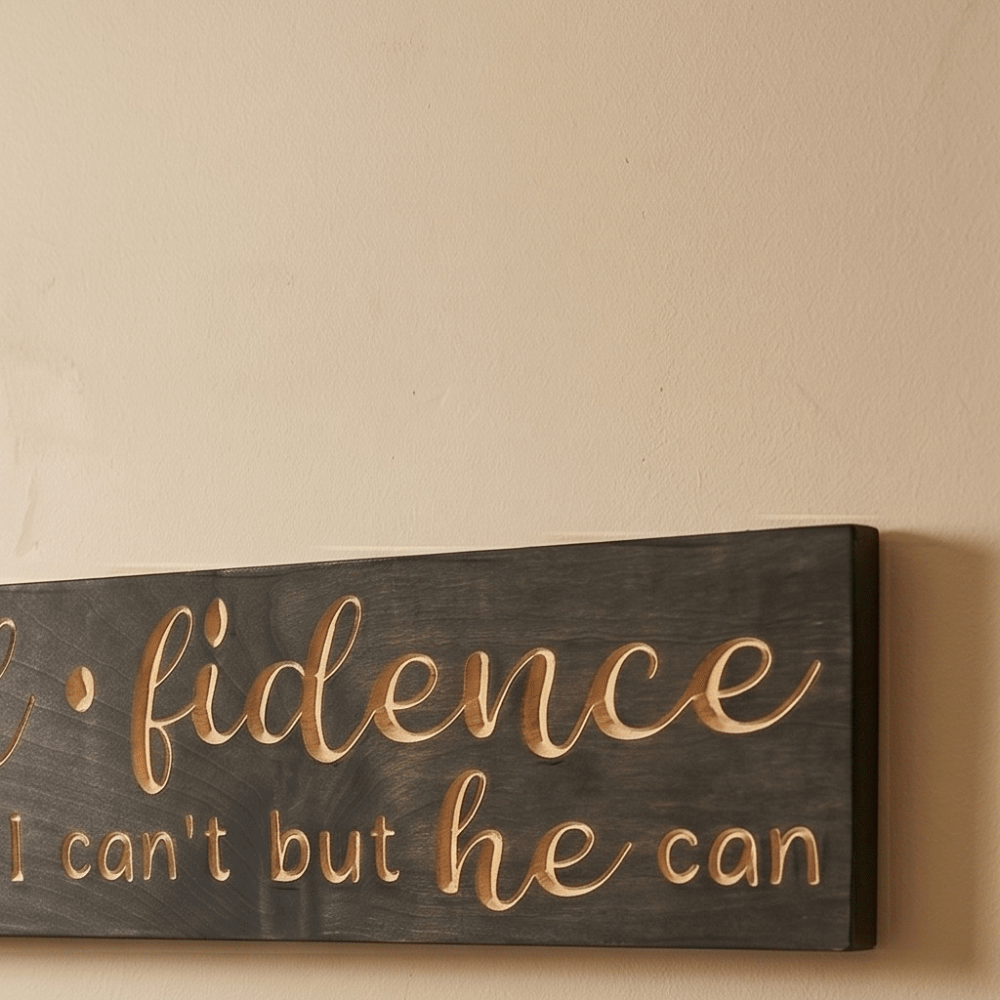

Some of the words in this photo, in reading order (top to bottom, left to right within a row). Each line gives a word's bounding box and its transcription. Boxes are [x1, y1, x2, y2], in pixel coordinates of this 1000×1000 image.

[130, 595, 822, 795] fidence
[9, 812, 24, 882] I
[61, 813, 231, 883] can't
[269, 809, 400, 883] but
[436, 769, 633, 912] he
[658, 826, 821, 887] can
